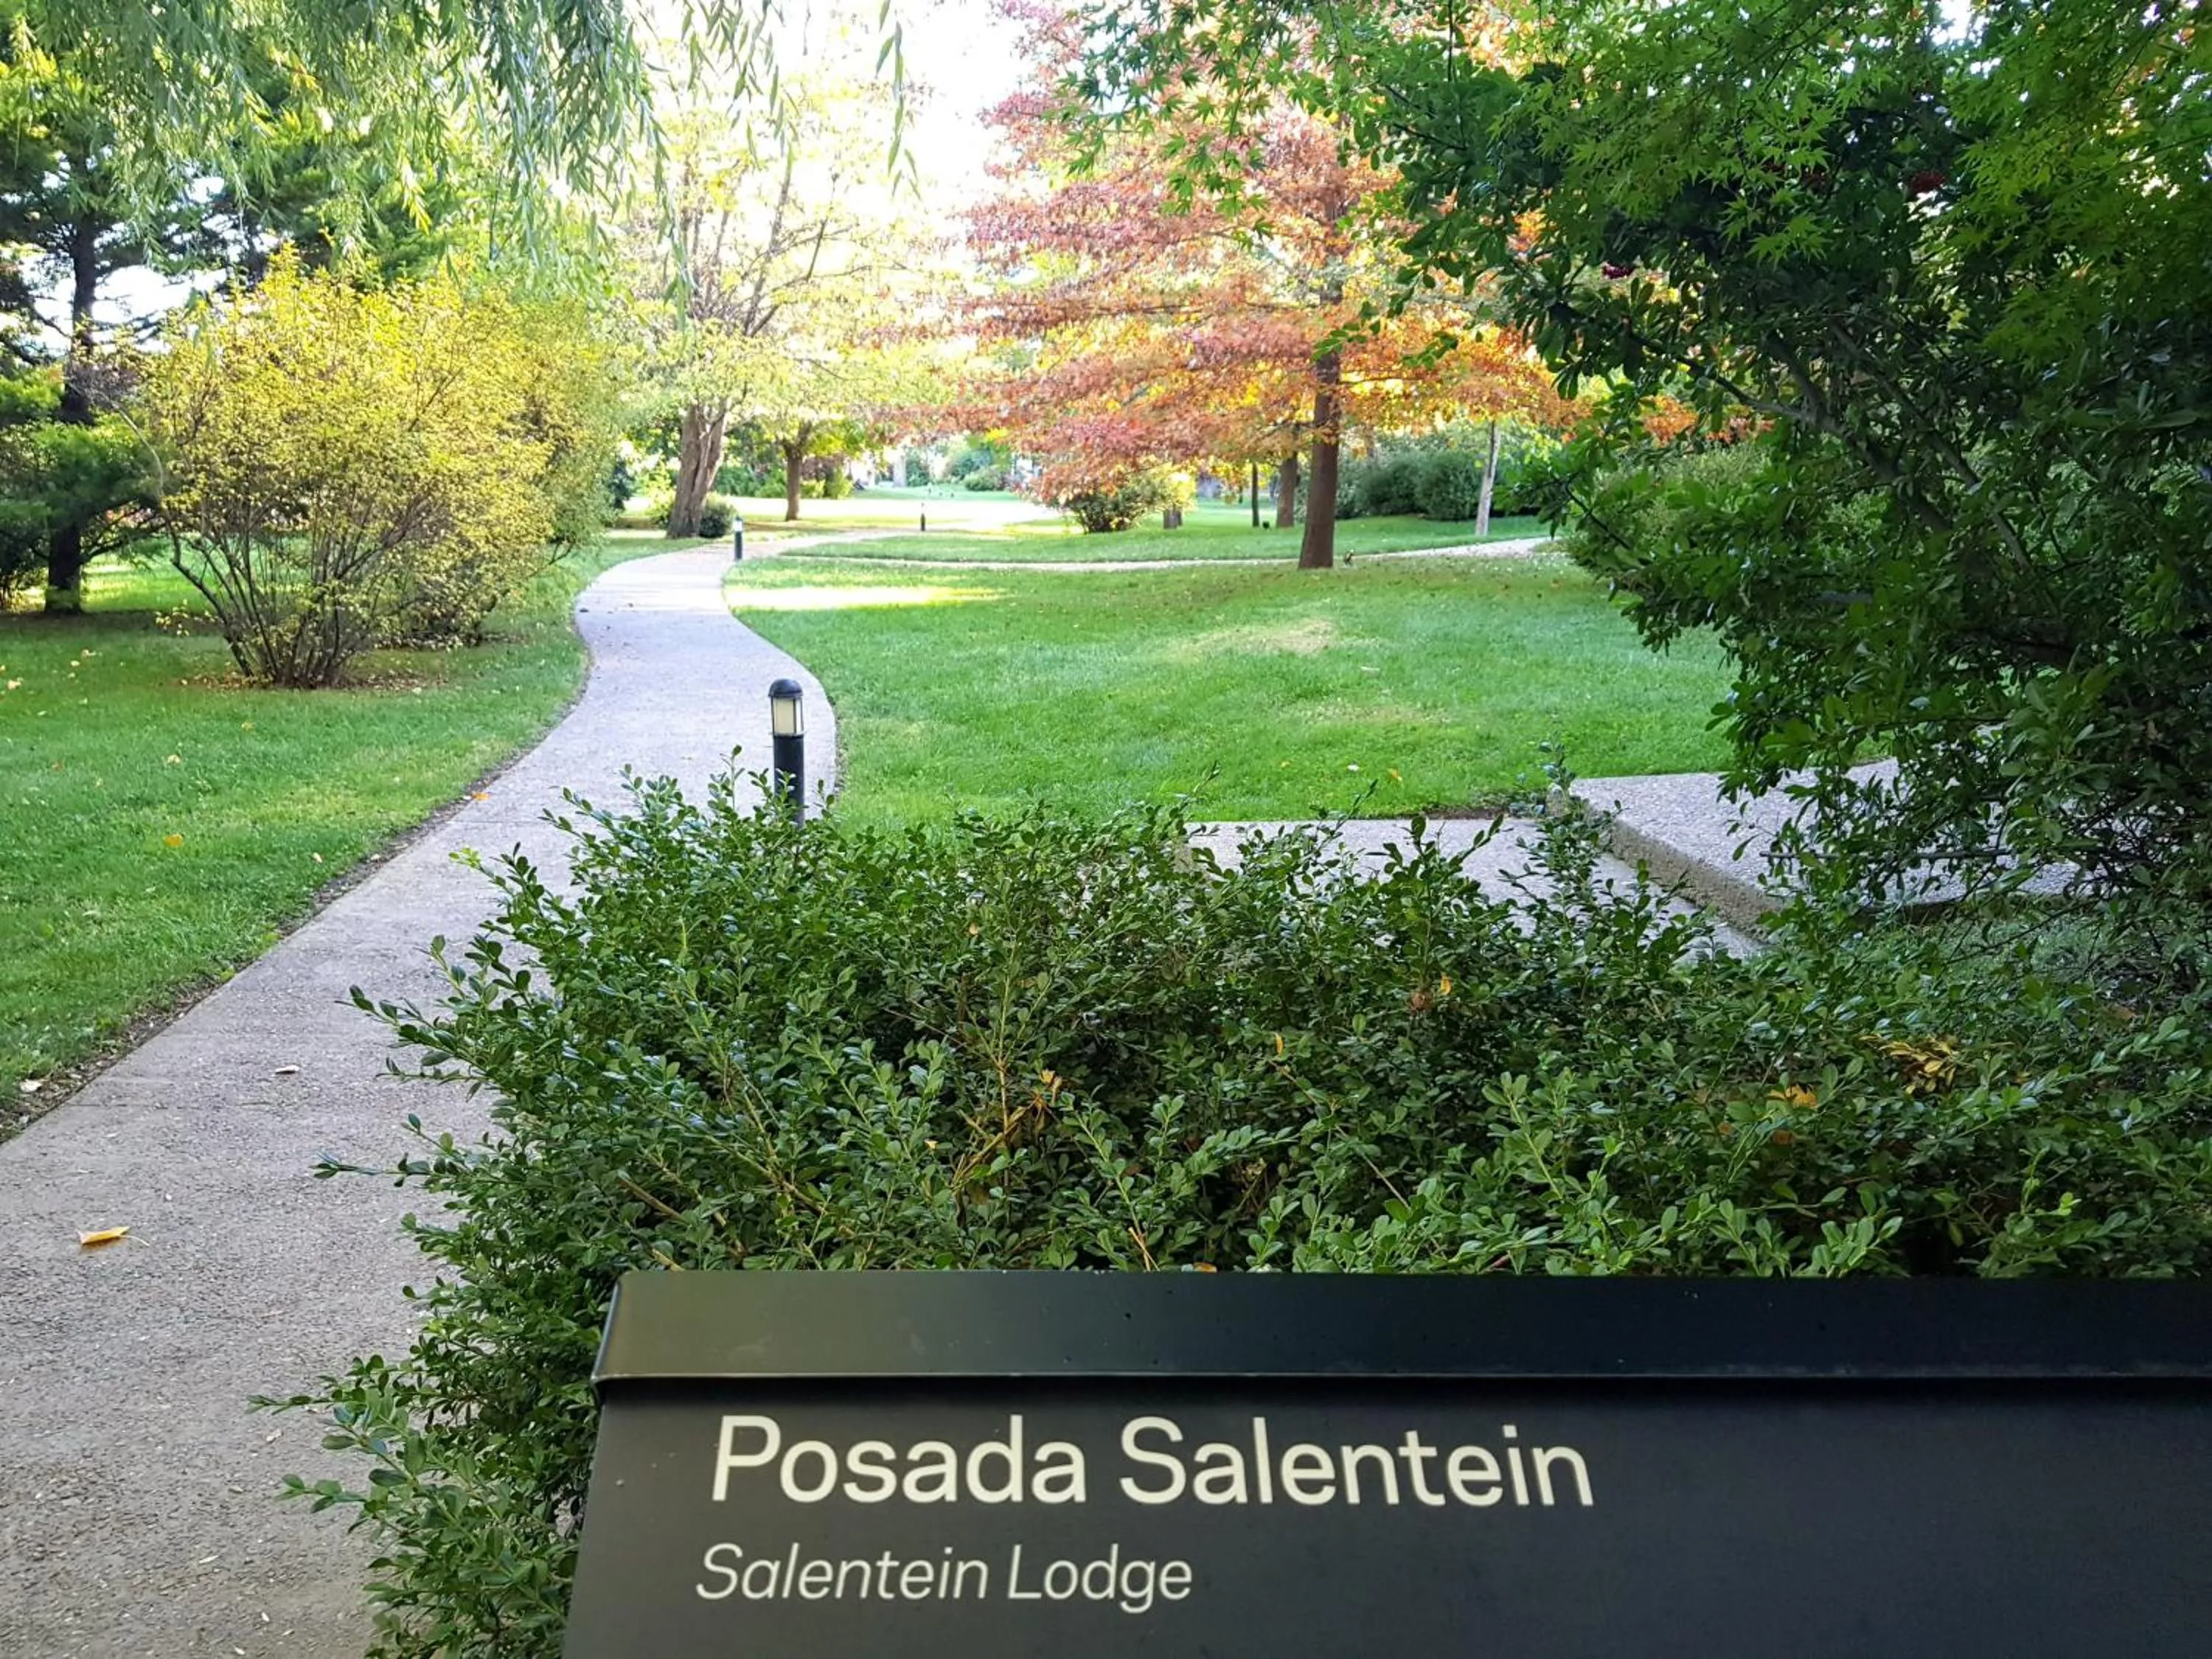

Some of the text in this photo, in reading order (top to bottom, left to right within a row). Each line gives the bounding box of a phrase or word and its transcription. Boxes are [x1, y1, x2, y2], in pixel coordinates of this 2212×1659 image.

[711, 1414, 1594, 1507] Posada Salentein
[695, 1542, 1193, 1614] Salentein Lodge
